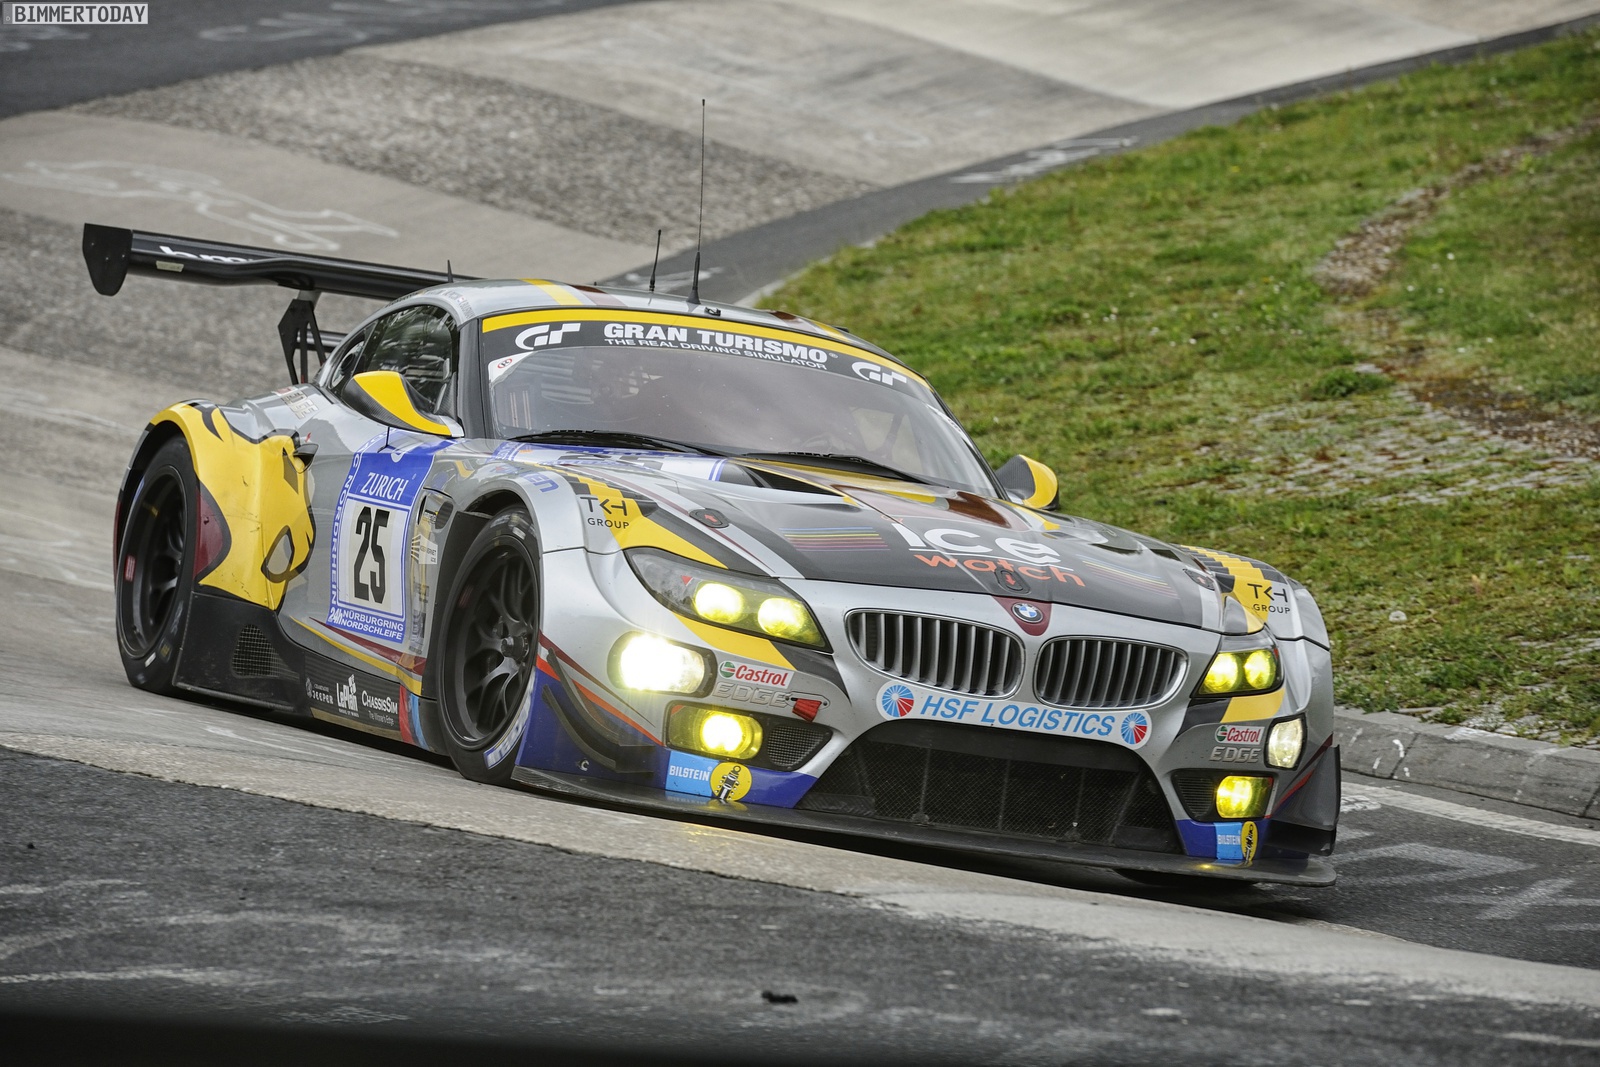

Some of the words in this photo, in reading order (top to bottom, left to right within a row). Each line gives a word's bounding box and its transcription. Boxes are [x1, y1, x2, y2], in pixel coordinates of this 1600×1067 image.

[515, 323, 581, 350] GT
[604, 323, 687, 342] GRAN
[697, 330, 828, 363] TURISMO
[638, 340, 679, 349] REAL
[680, 343, 741, 355] DRIVING
[743, 350, 828, 370] SIMULATOR
[360, 472, 409, 501] ZURICH
[587, 517, 630, 529] GROUP
[331, 475, 353, 605] NORDRHEIN
[891, 523, 1062, 565] ice
[354, 506, 390, 605] 25
[914, 554, 1086, 587] watch
[342, 610, 404, 632] NÜRBURGRING
[1253, 603, 1291, 615] GROUP
[339, 619, 403, 640] NORDSCHLEIFE
[735, 665, 789, 687] Castrol
[312, 691, 333, 704] JEEPER
[712, 682, 790, 708] EDGE
[920, 695, 979, 720] HSF
[980, 703, 1116, 736] LOGISTICS
[1226, 727, 1261, 742] Castrol
[1209, 746, 1262, 763] EDGE
[669, 765, 712, 782] BILSTEIN
[1217, 834, 1241, 845] BILSTEIN
